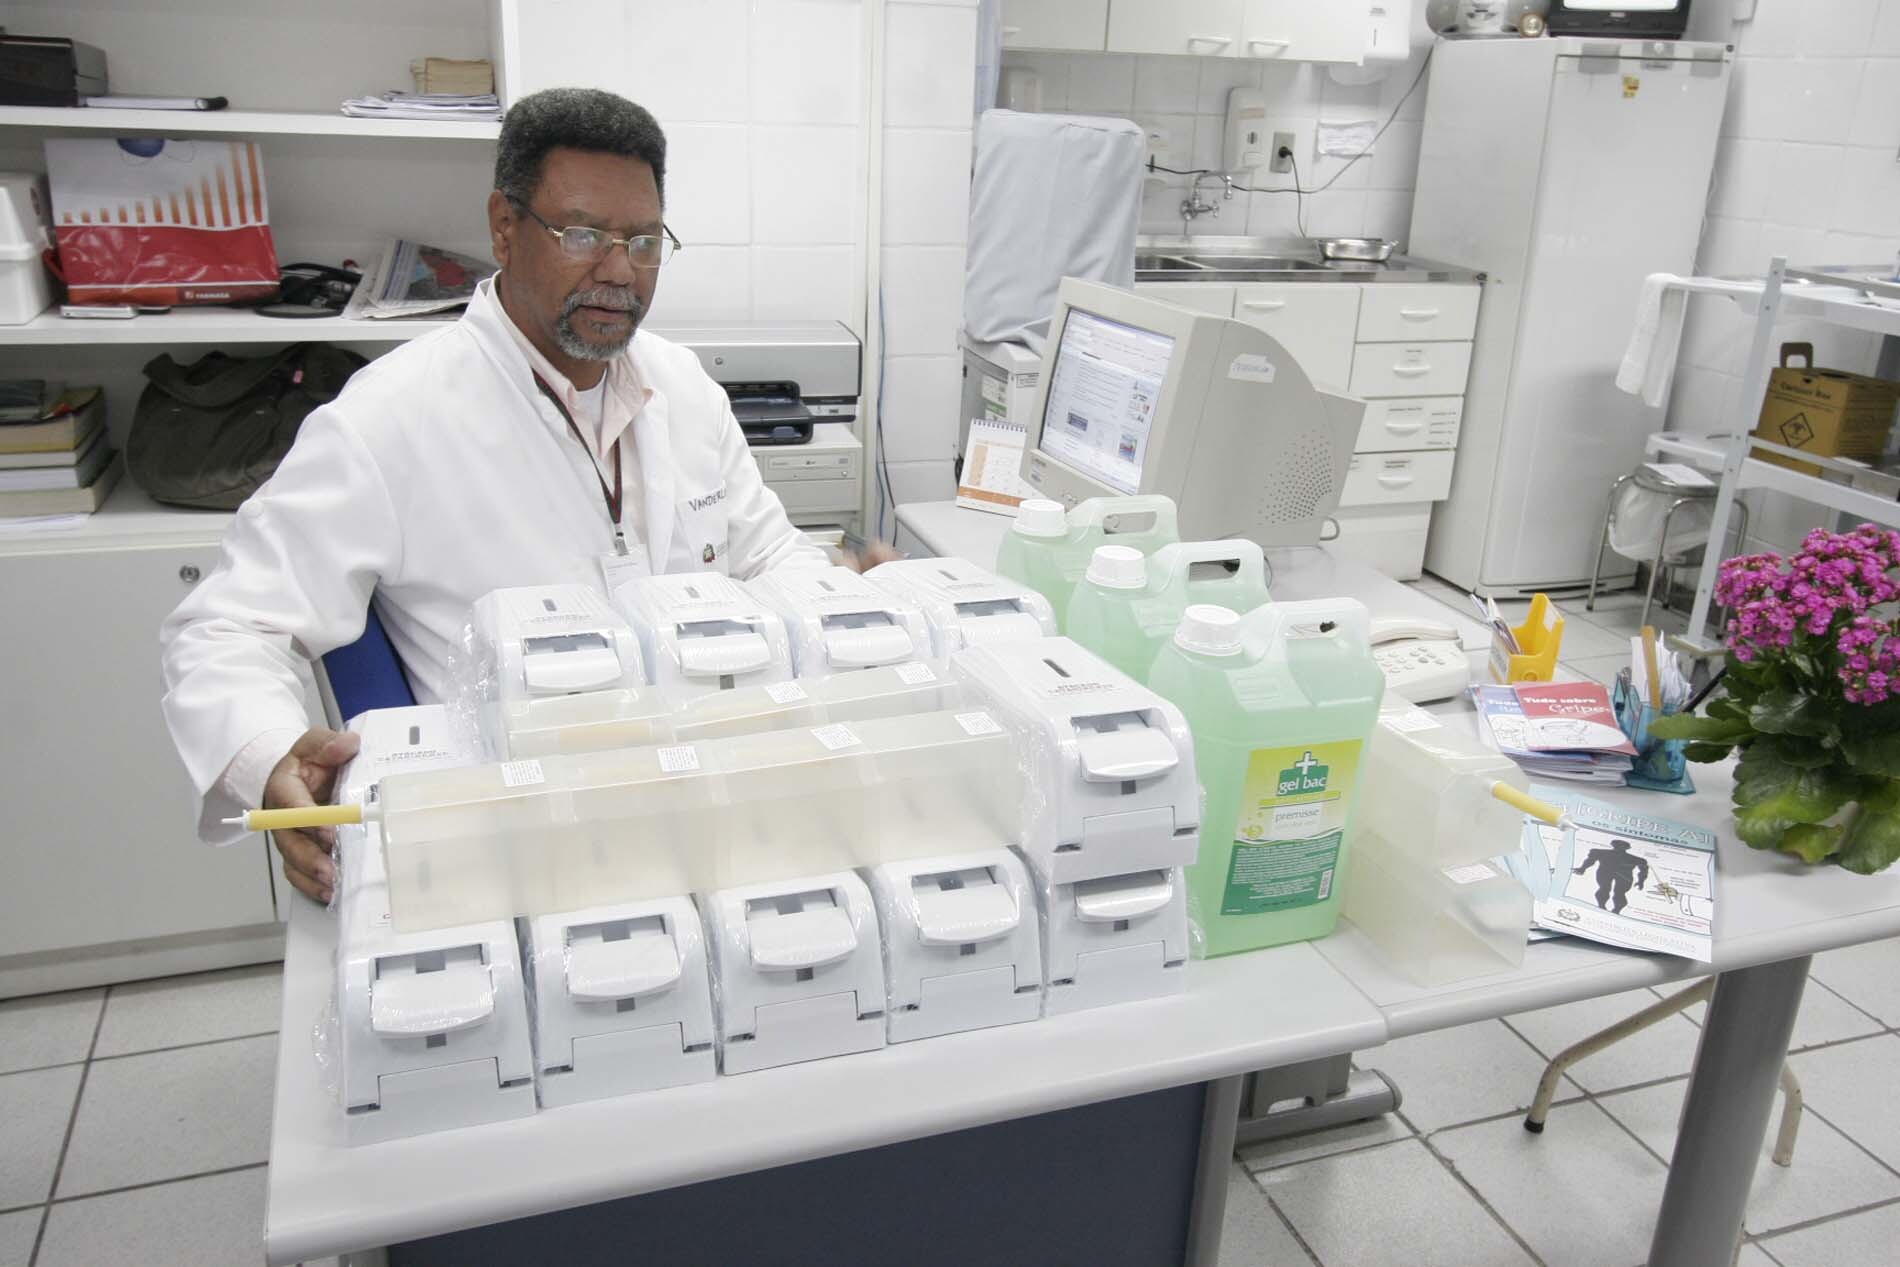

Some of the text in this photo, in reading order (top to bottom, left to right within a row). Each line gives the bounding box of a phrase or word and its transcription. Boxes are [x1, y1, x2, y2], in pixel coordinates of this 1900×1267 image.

[1278, 775, 1327, 794] gel bac
[1615, 826, 1689, 845] sintomas
